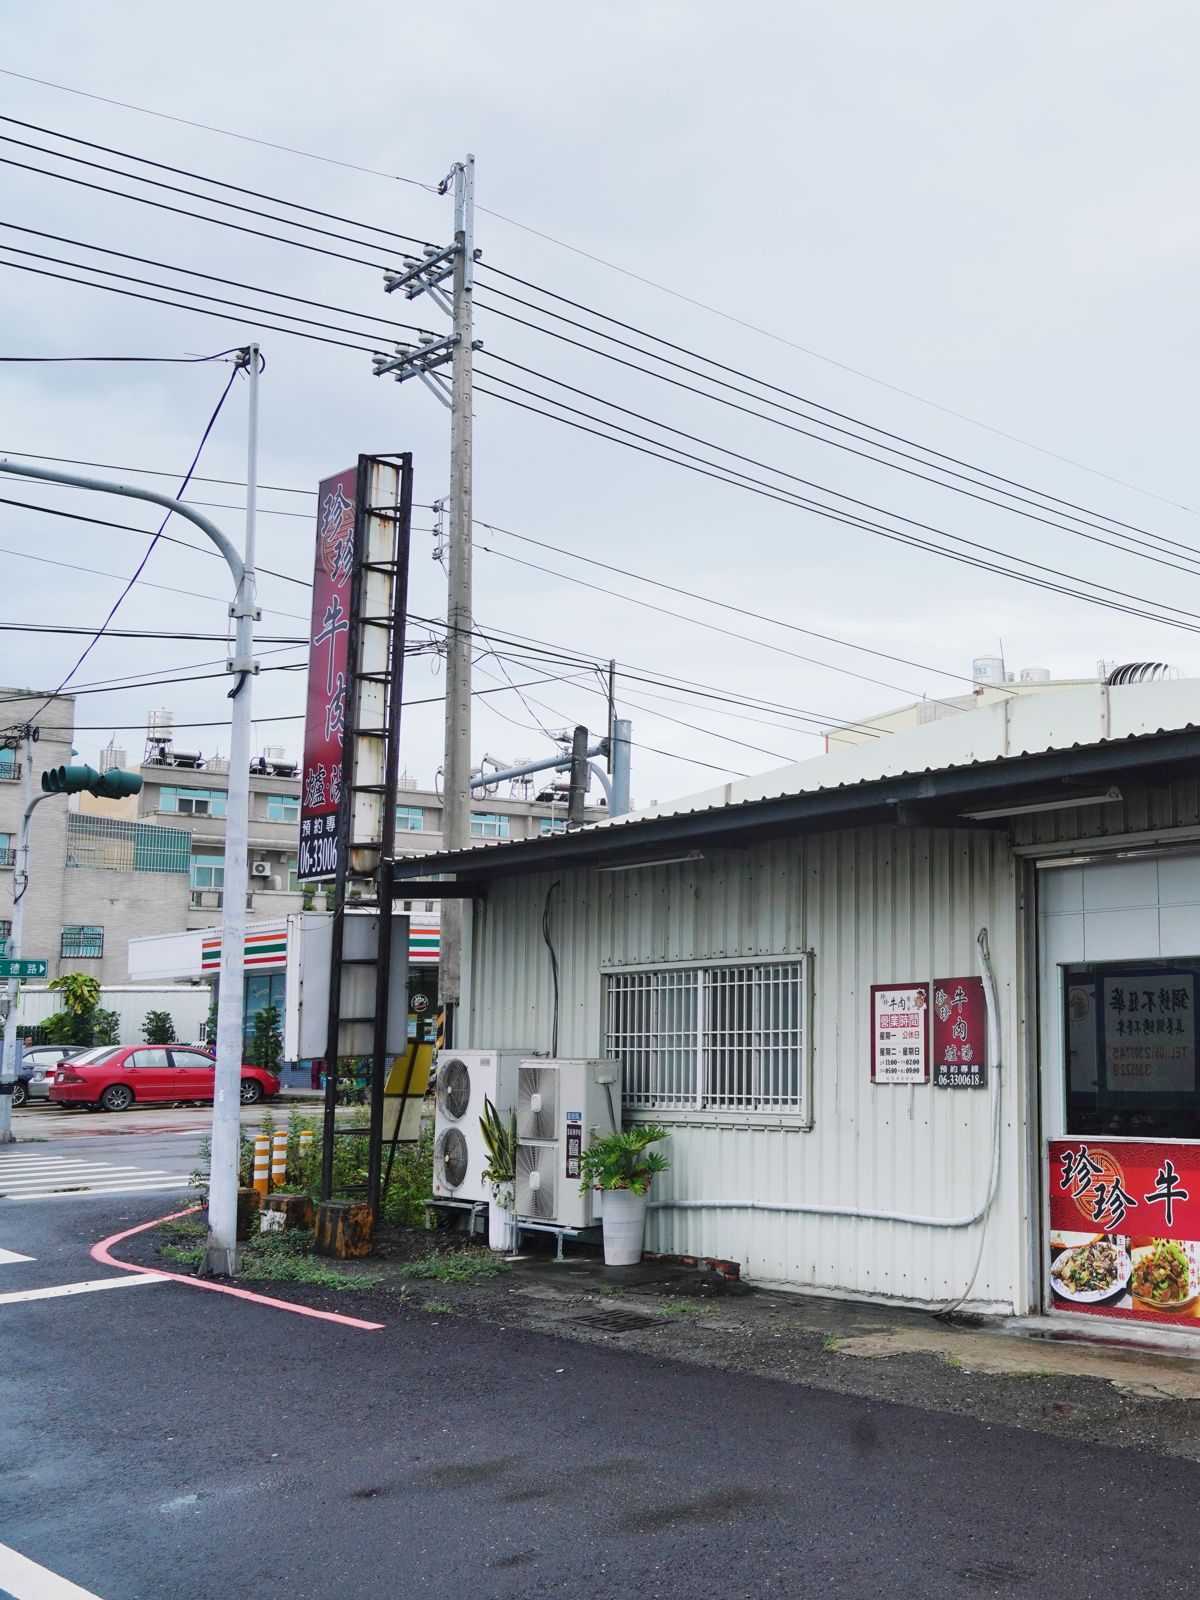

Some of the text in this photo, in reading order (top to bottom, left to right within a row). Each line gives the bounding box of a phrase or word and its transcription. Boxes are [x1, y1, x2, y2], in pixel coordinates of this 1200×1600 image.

[302, 815, 336, 837] 預約專
[300, 836, 338, 875] 06-33006
[0, 963, 37, 975] 德路
[880, 1013, 920, 1028] 營業時間
[951, 985, 969, 1042] 牛肉
